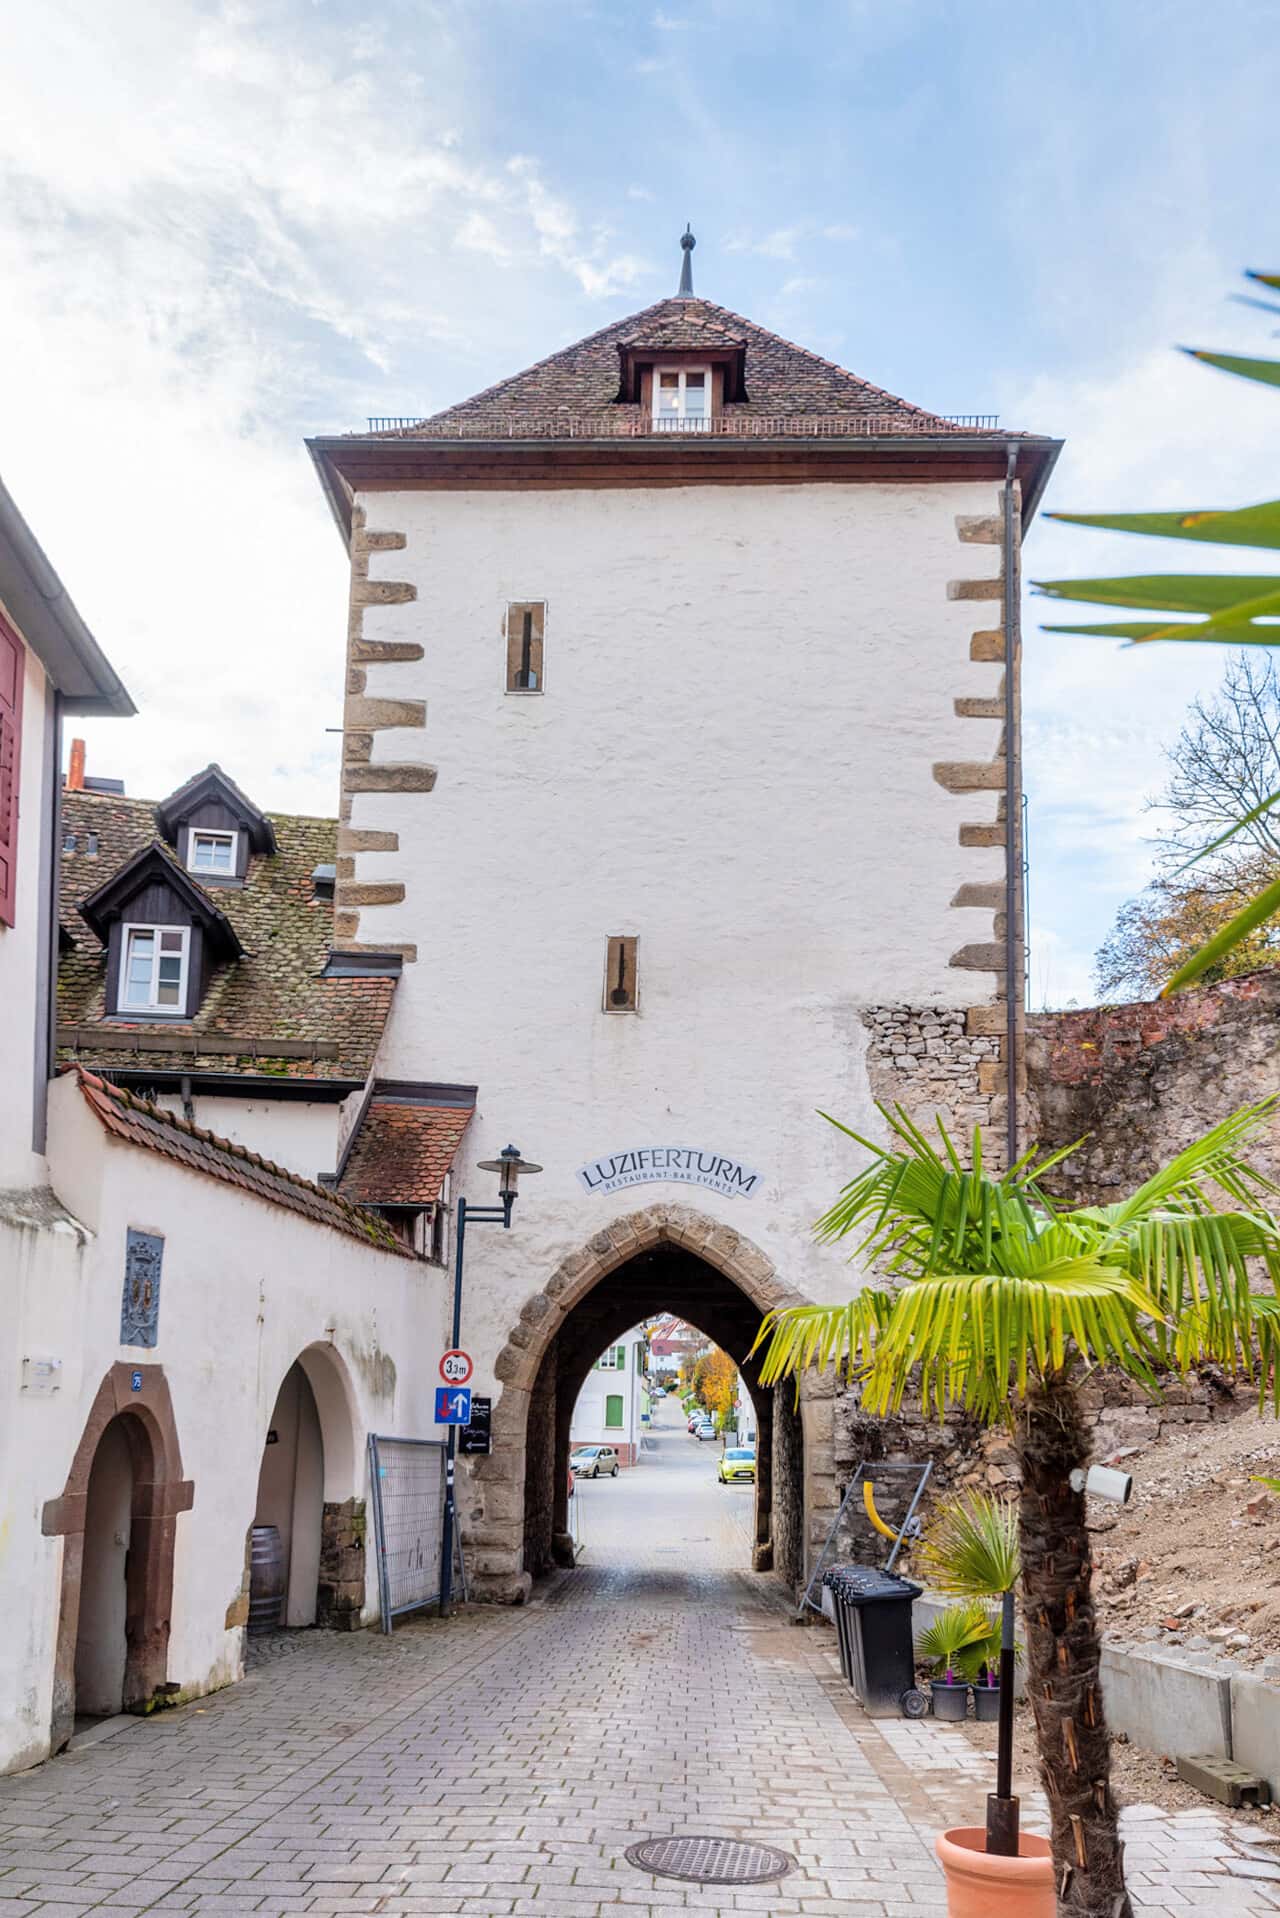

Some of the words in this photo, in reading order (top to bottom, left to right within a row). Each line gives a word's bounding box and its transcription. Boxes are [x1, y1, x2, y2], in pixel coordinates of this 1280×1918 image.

[582, 1149, 757, 1192] LUZIFERTURM
[605, 1171, 667, 1190] RESTAURANT
[674, 1172, 692, 1180] BAR
[696, 1173, 732, 1193] EVENTS
